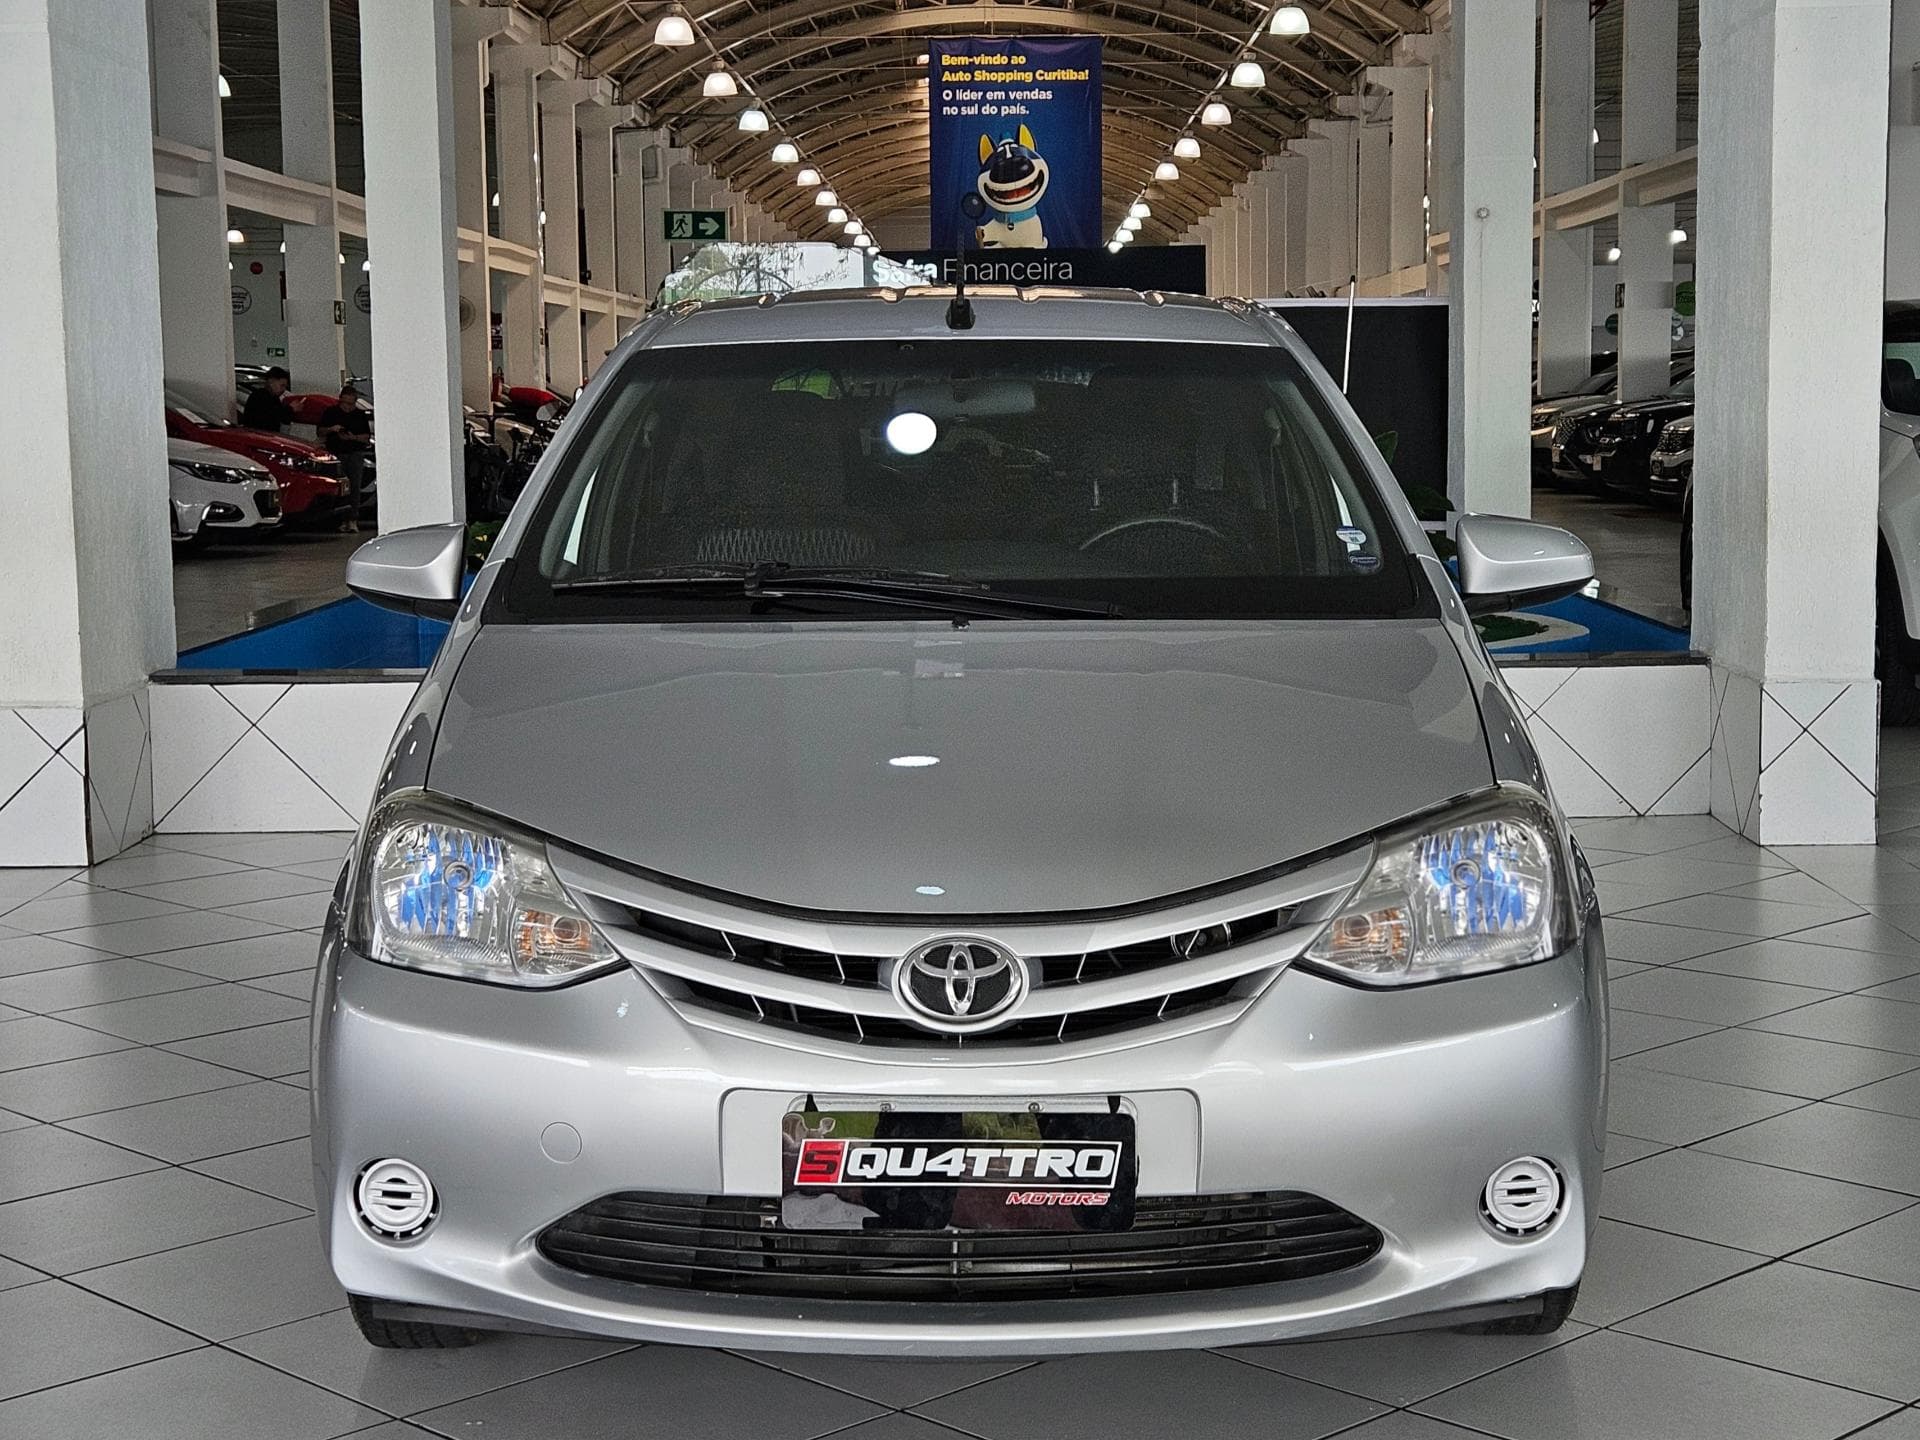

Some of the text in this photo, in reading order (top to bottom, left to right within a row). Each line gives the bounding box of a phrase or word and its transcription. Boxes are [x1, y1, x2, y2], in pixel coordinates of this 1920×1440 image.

[941, 54, 1026, 65] Bem-vindo ao
[942, 69, 1089, 83] Auto Shopping Curitiba!
[942, 88, 1053, 100] O líder em vendas
[942, 103, 1029, 117] no sul do país.
[943, 257, 1073, 281] Fnanceira
[1005, 1192, 1110, 1206] MOTORS
